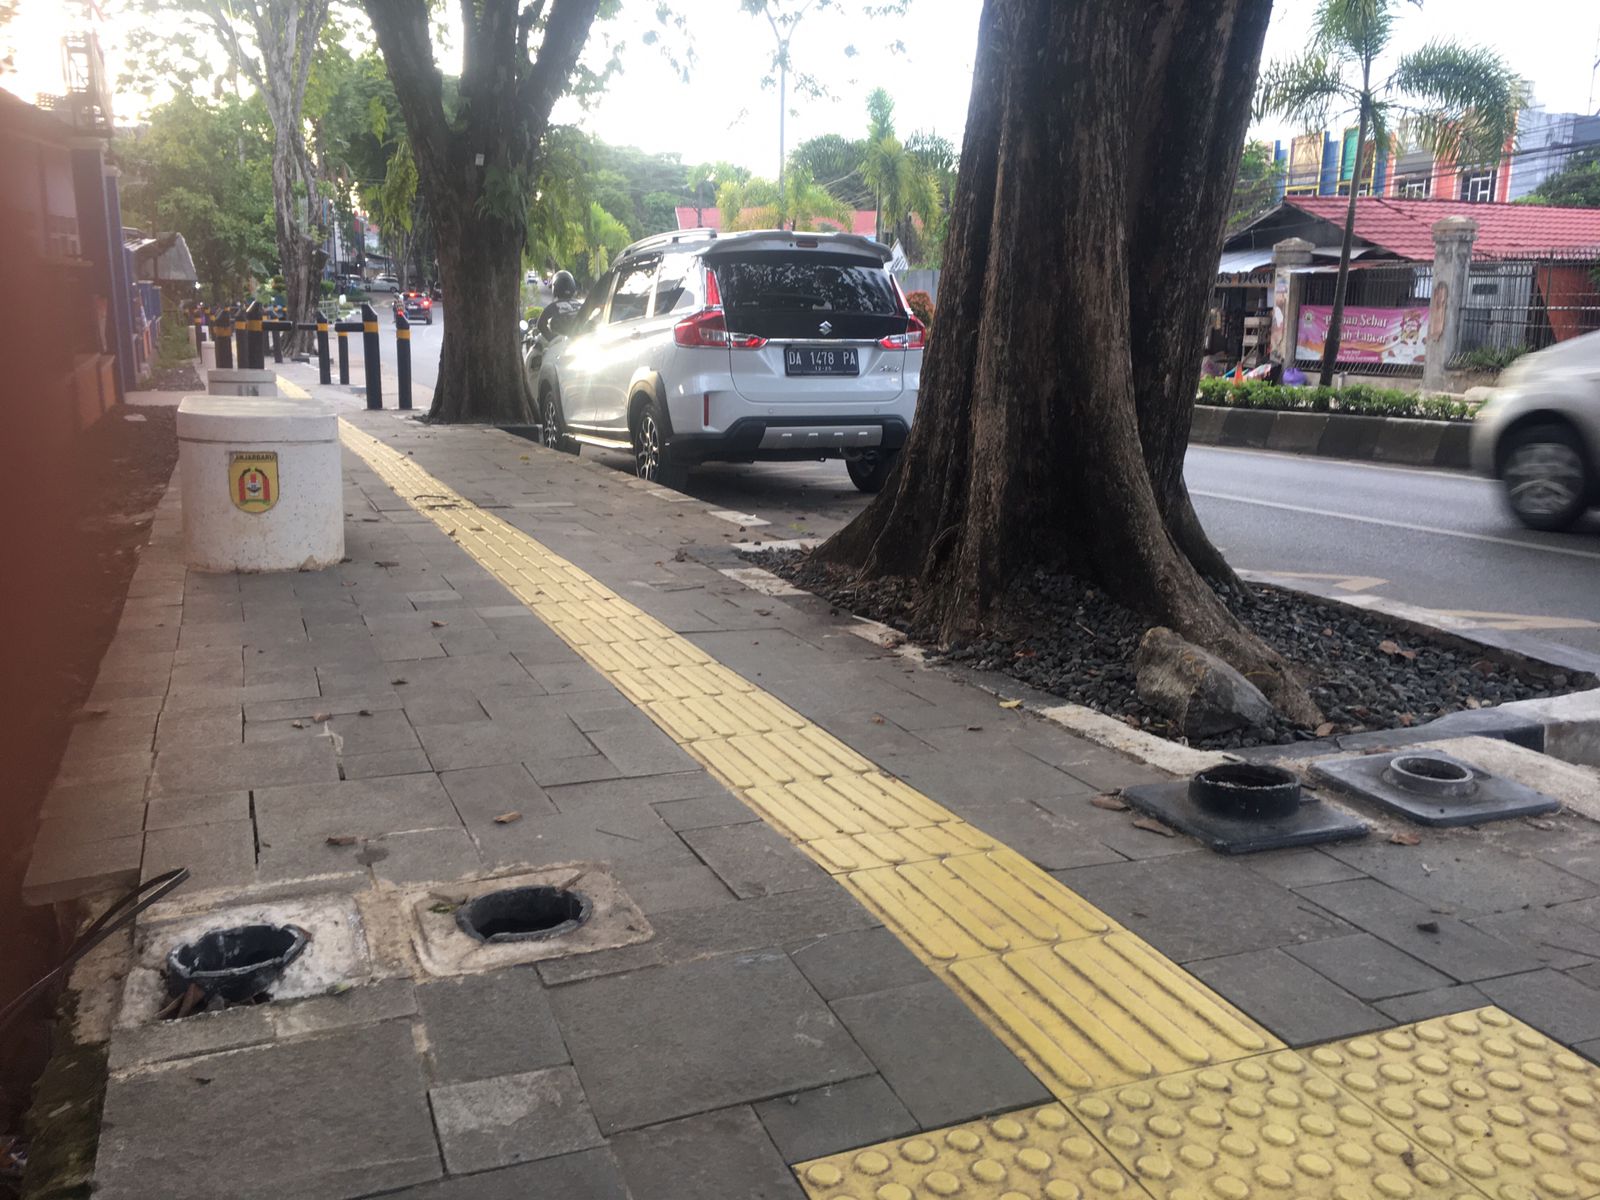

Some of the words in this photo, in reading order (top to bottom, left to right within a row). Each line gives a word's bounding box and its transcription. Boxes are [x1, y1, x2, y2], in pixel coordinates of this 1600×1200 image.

[789, 351, 802, 365] DA
[810, 351, 834, 365] 1478
[843, 351, 856, 365] PA
